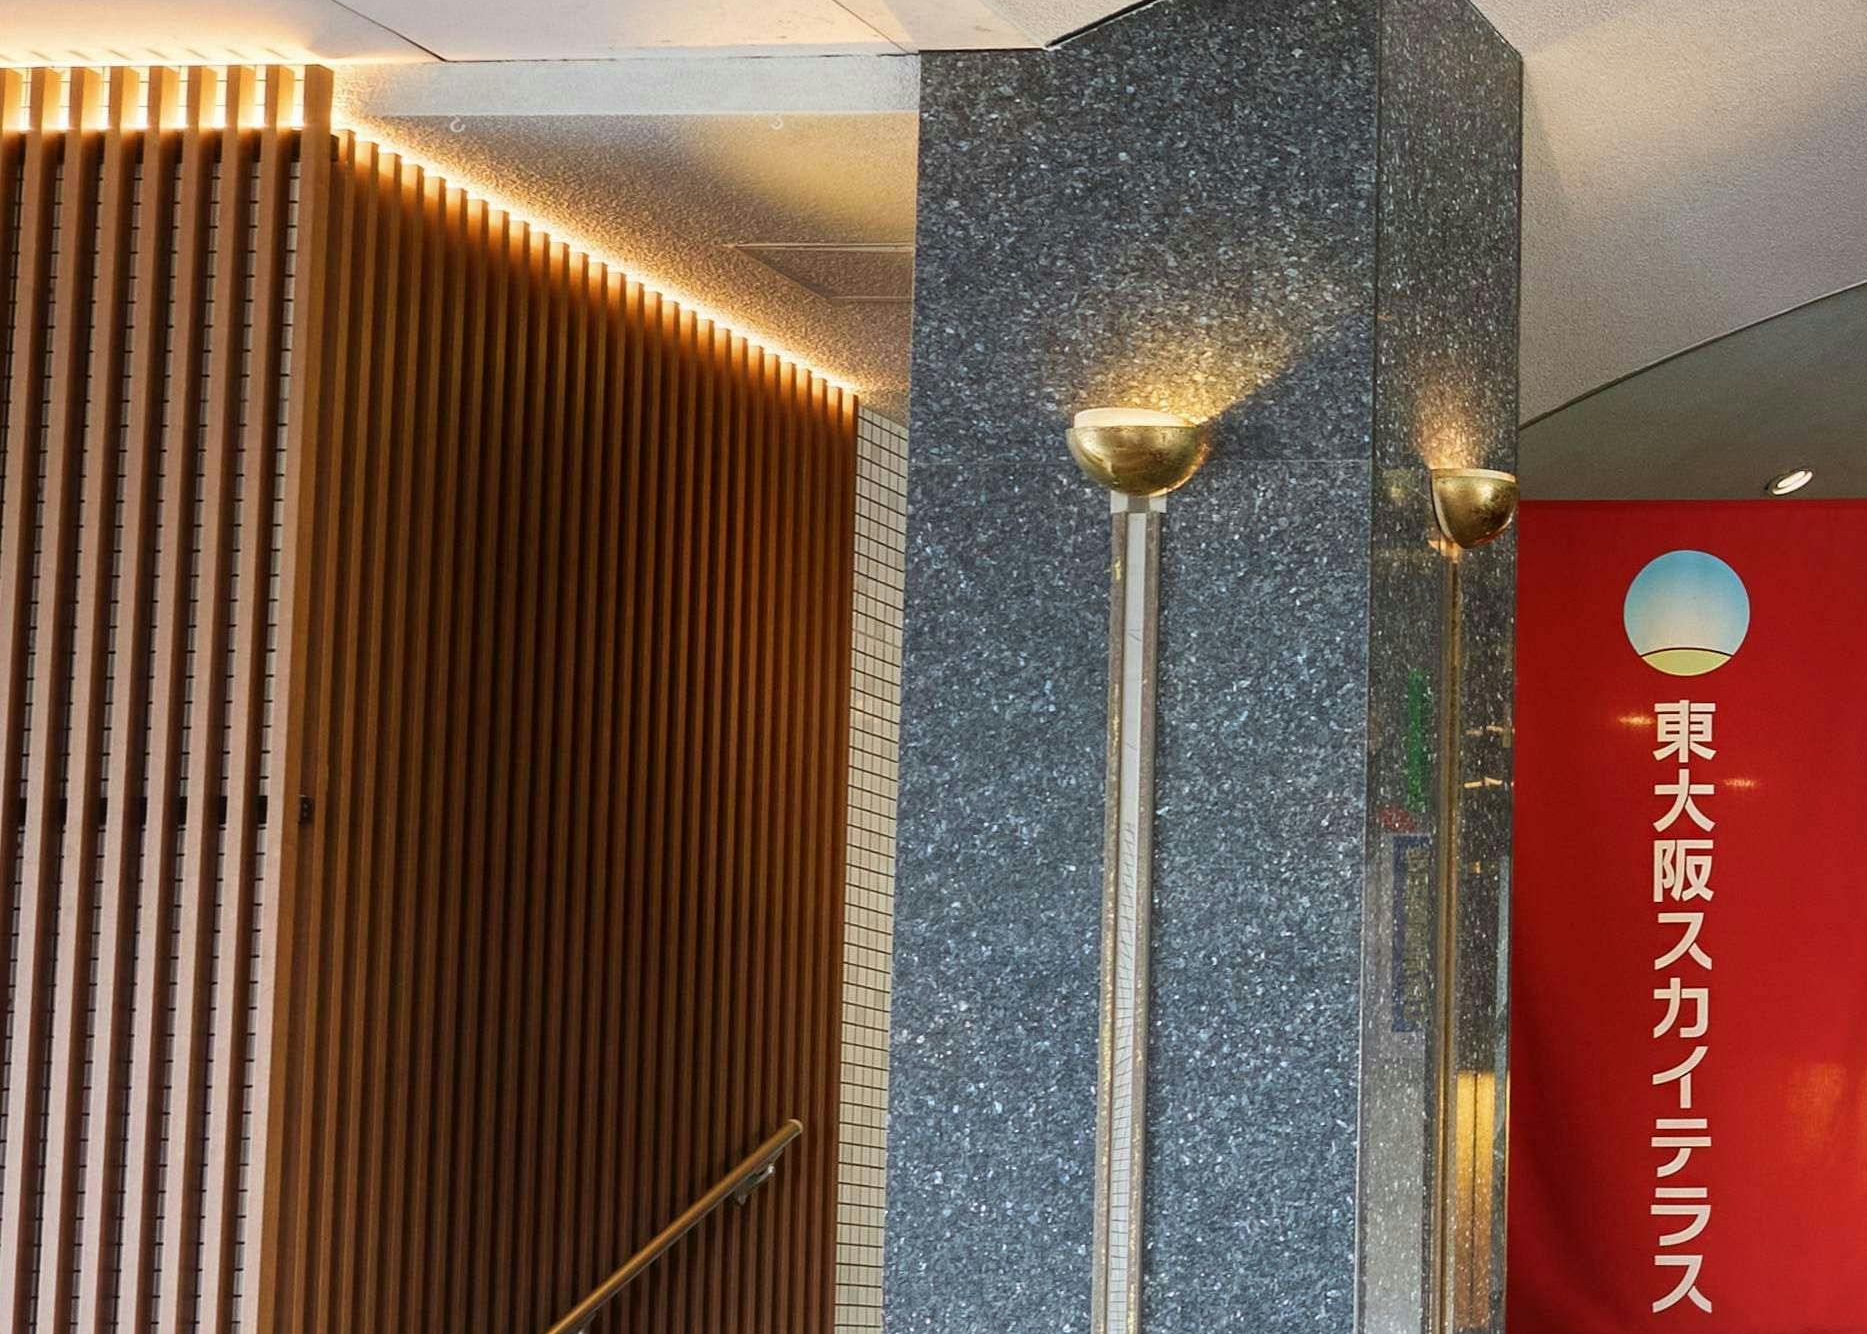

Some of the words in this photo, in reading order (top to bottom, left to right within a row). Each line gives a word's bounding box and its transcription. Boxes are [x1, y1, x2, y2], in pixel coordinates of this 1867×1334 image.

[1651, 699, 1716, 1314] 東大阪スカイテラス
